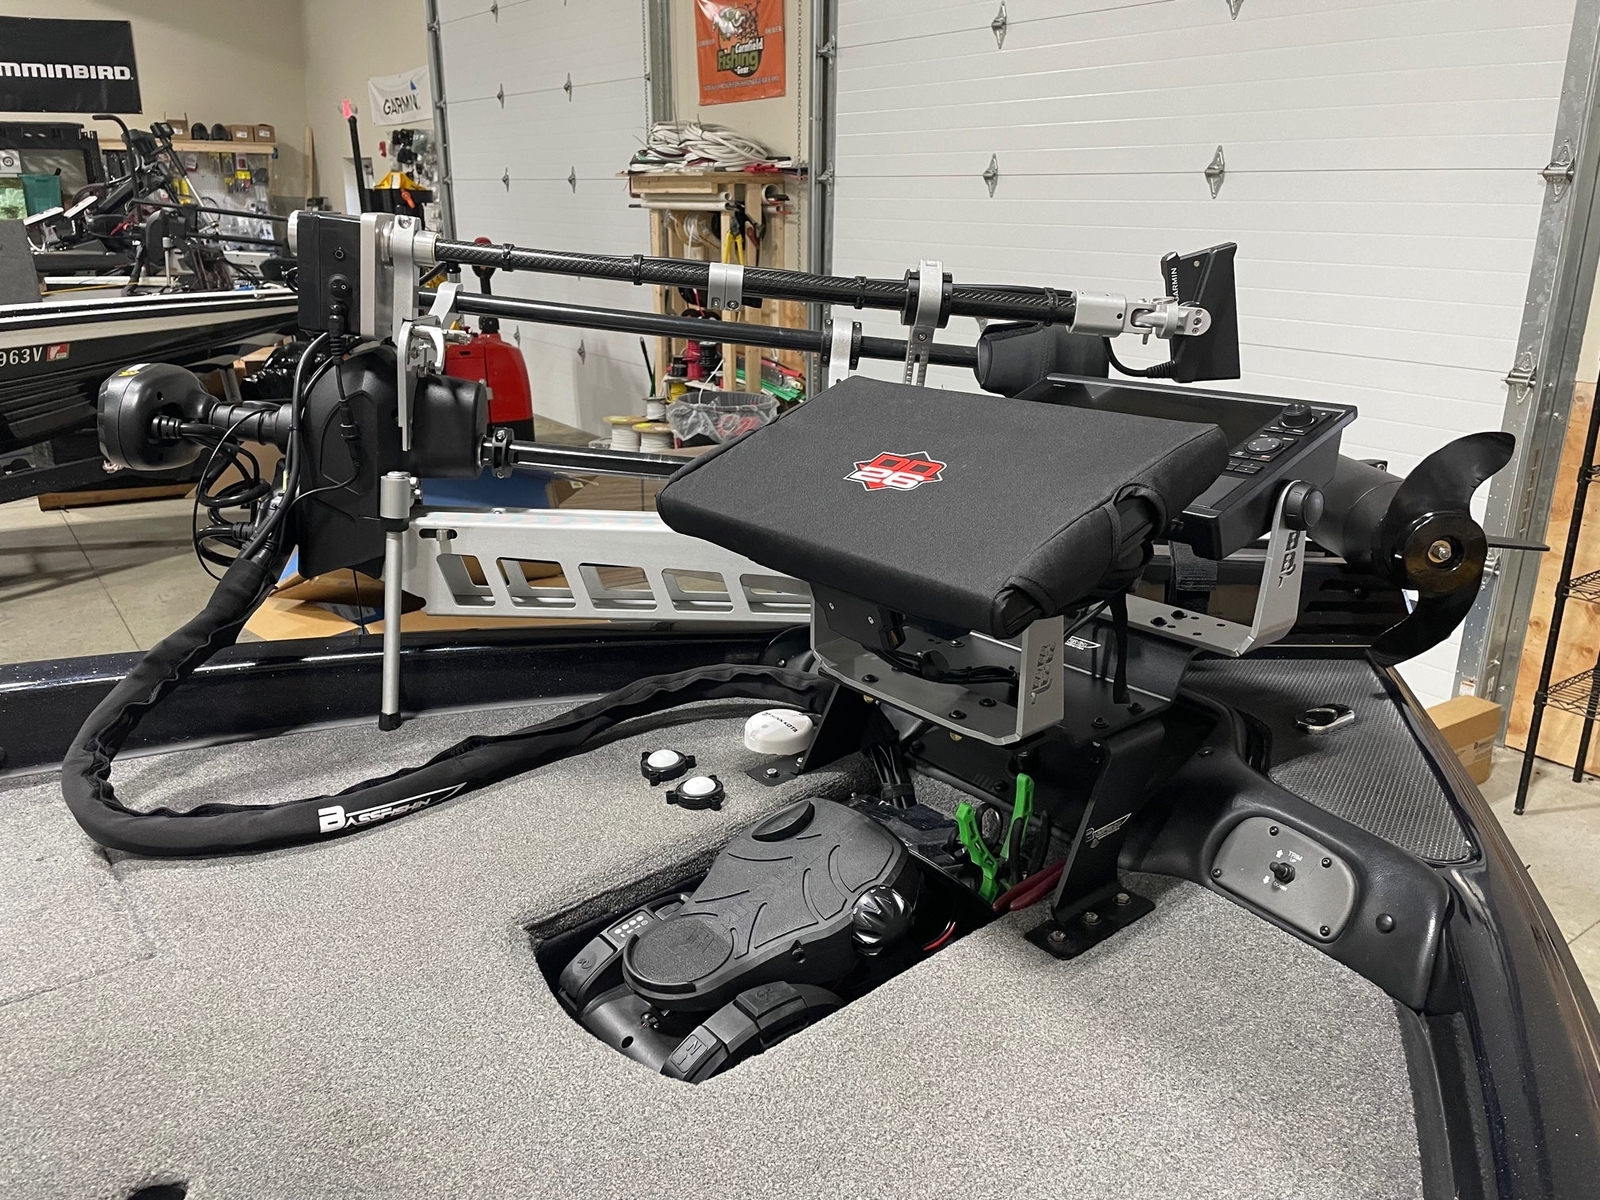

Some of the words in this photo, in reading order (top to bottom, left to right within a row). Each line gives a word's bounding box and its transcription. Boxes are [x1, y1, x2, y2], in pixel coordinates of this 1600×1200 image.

[718, 49, 759, 72] Fishing
[383, 94, 419, 115] GARMIN
[1288, 850, 1303, 862] TRIM
